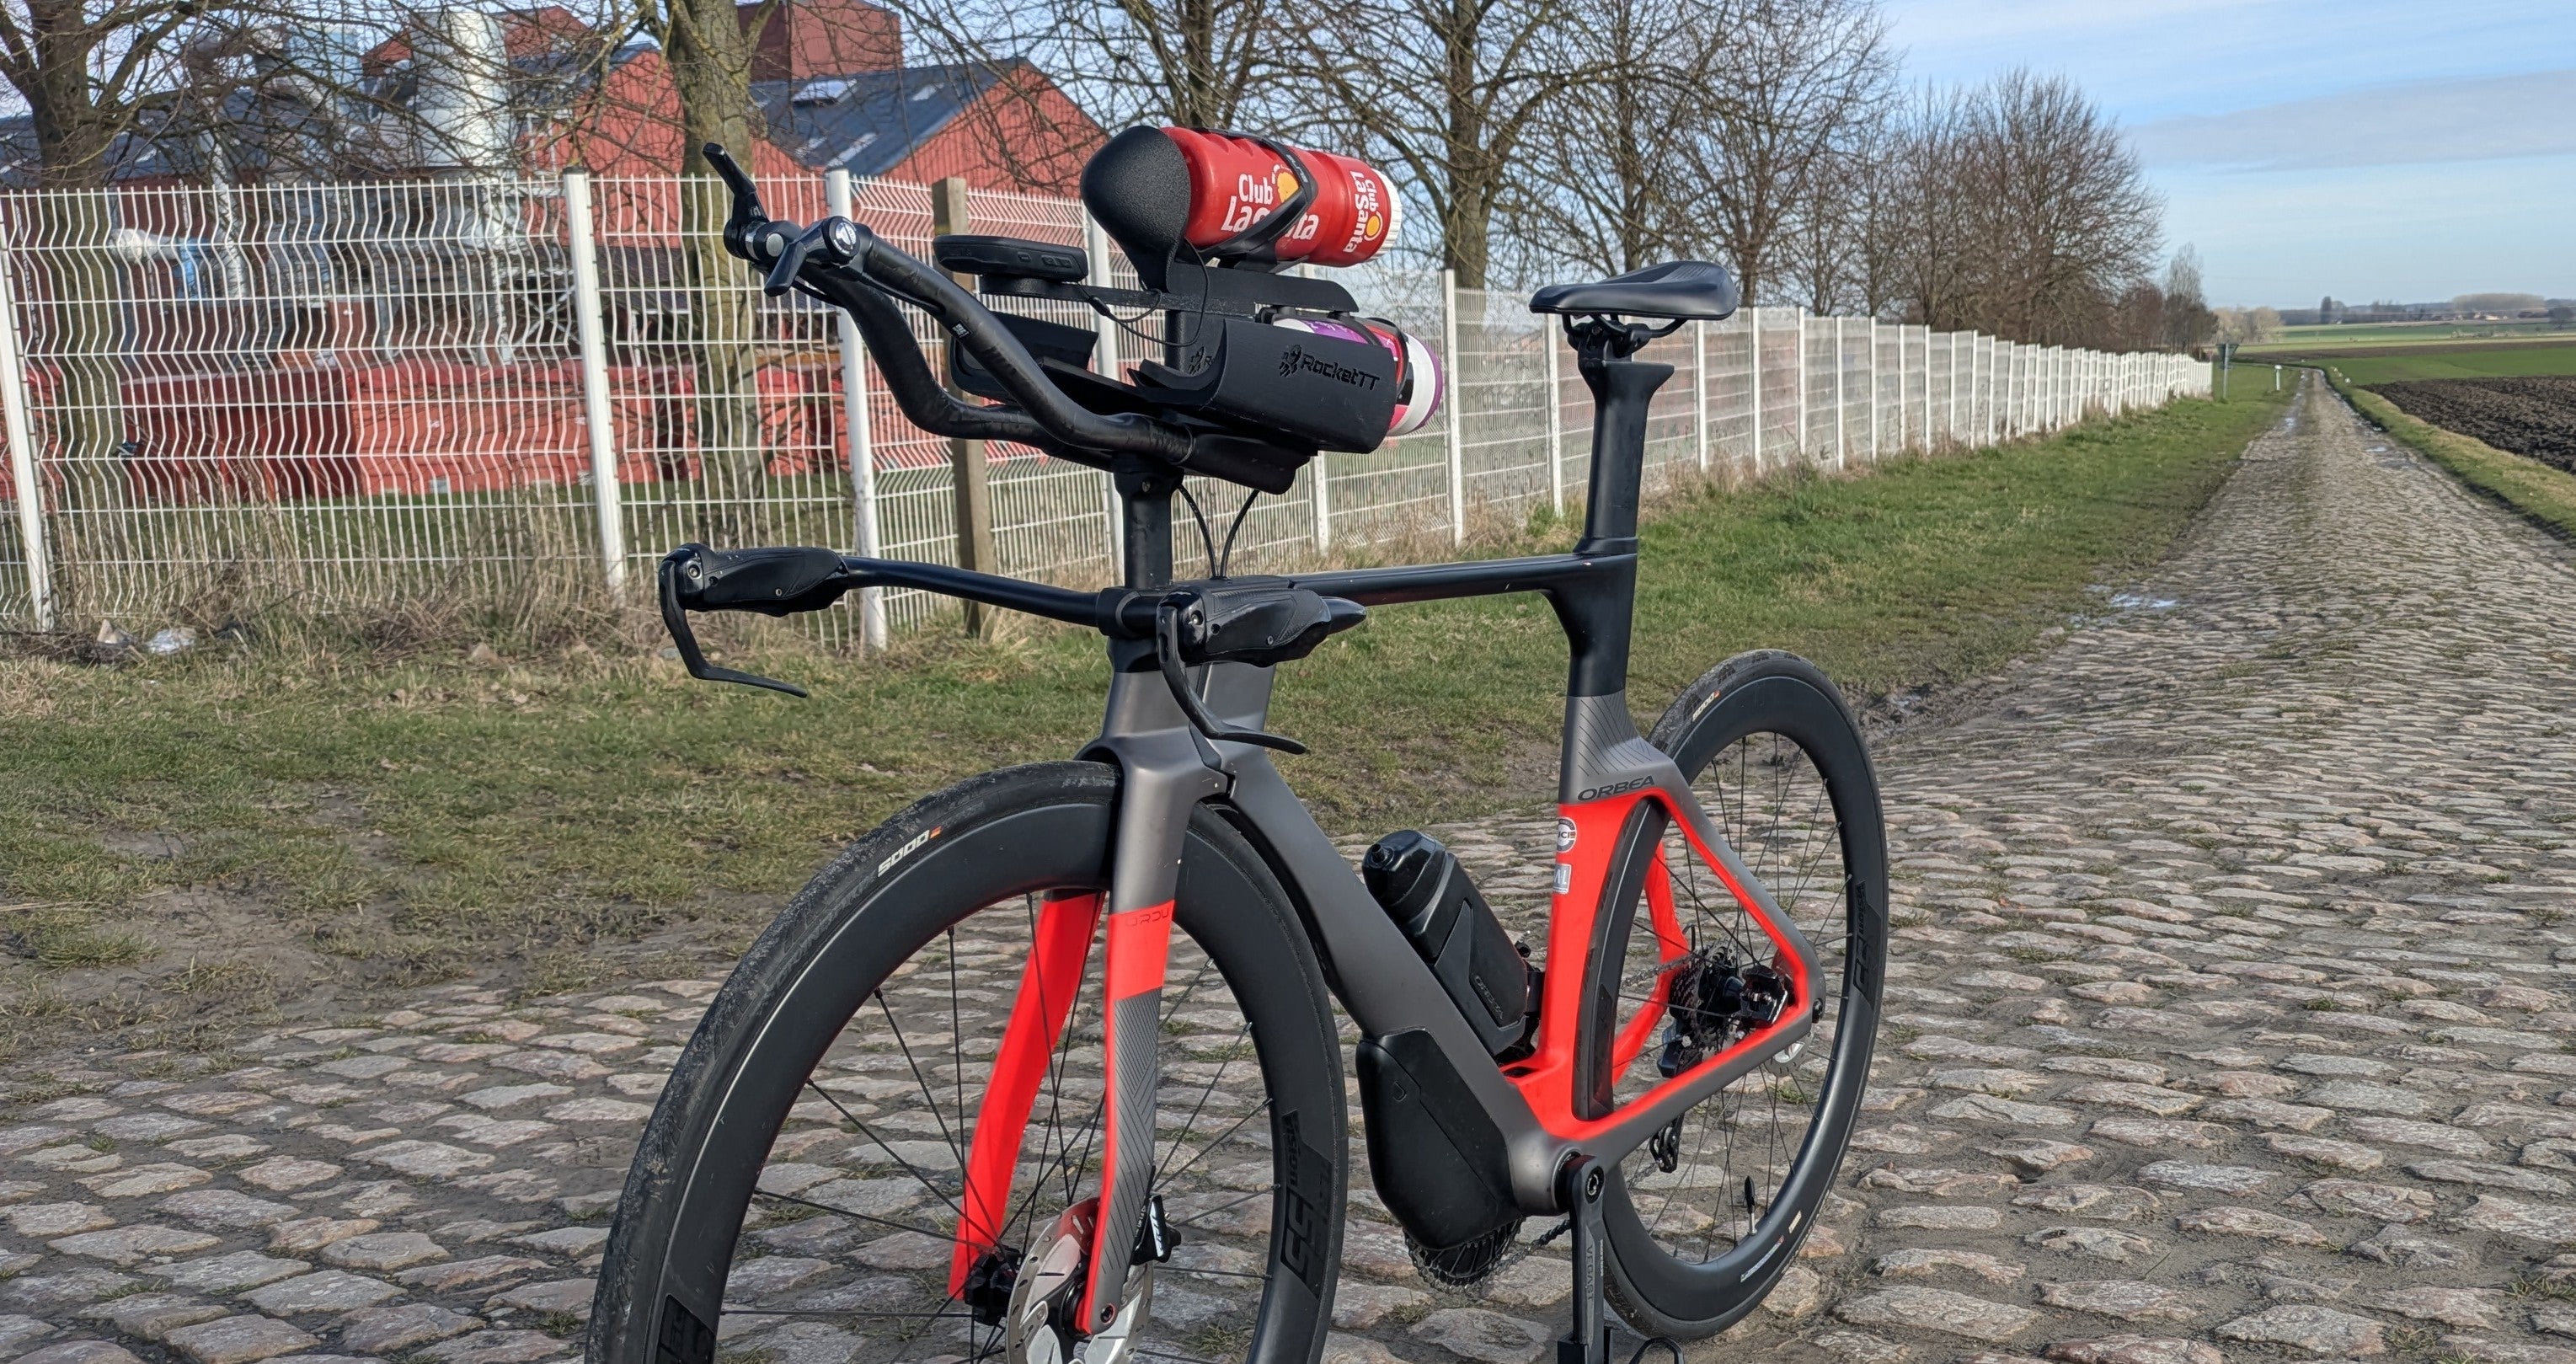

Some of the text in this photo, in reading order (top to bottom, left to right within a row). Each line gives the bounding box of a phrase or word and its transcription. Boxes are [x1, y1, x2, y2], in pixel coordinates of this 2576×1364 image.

[1238, 174, 1274, 205] Club
[1365, 179, 1380, 212] Club
[1221, 195, 1319, 240] Lata
[1301, 354, 1381, 390] RocketTT
[1577, 775, 1655, 800] ORBEA
[878, 829, 930, 877] 5000
